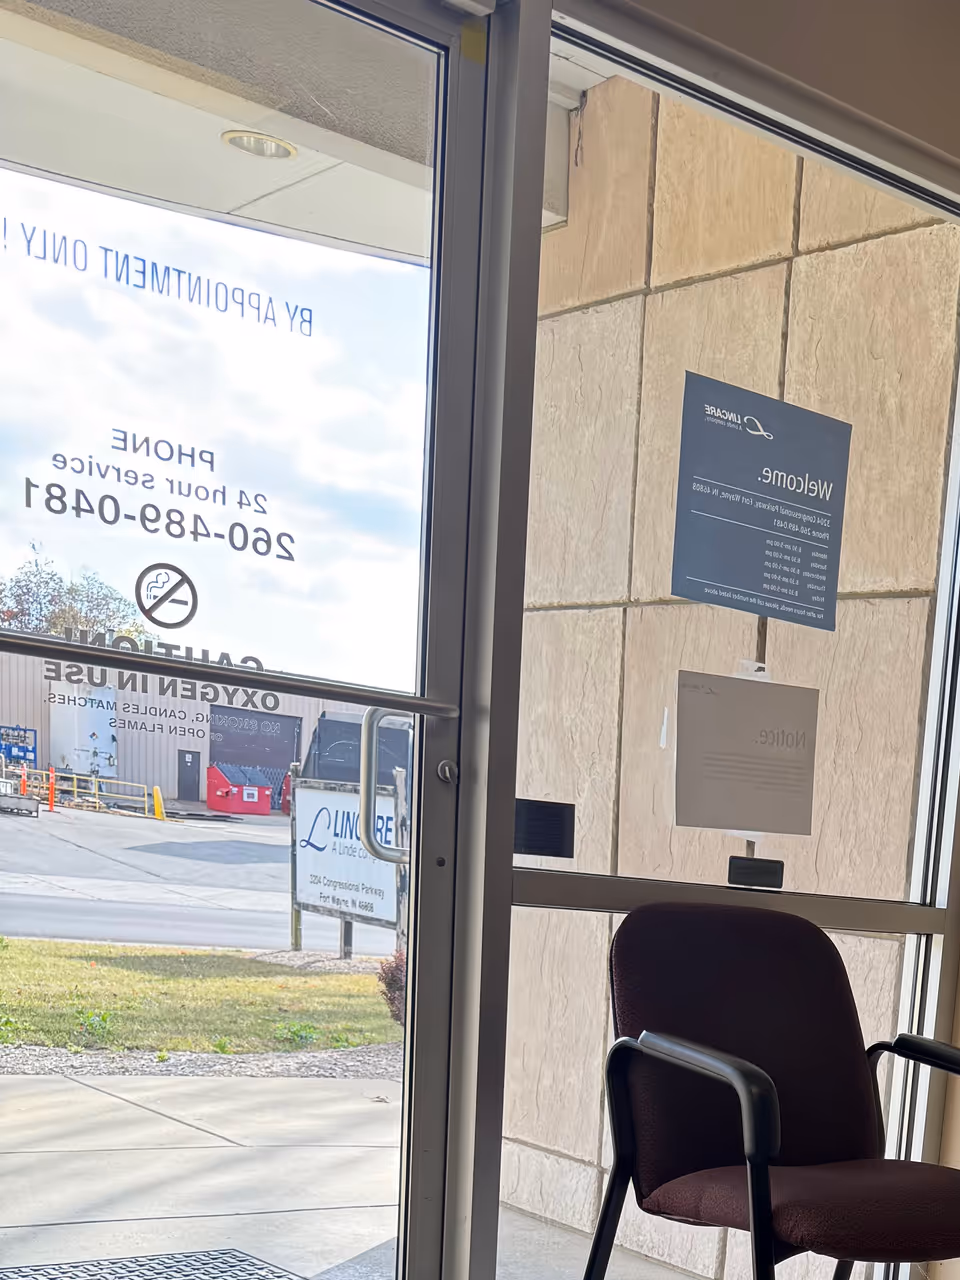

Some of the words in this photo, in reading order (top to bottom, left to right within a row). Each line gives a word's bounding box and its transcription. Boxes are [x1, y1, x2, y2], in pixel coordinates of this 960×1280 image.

[323, 876, 360, 892] Congressional
[361, 883, 385, 900] Parkway
[320, 892, 330, 902] Fort
